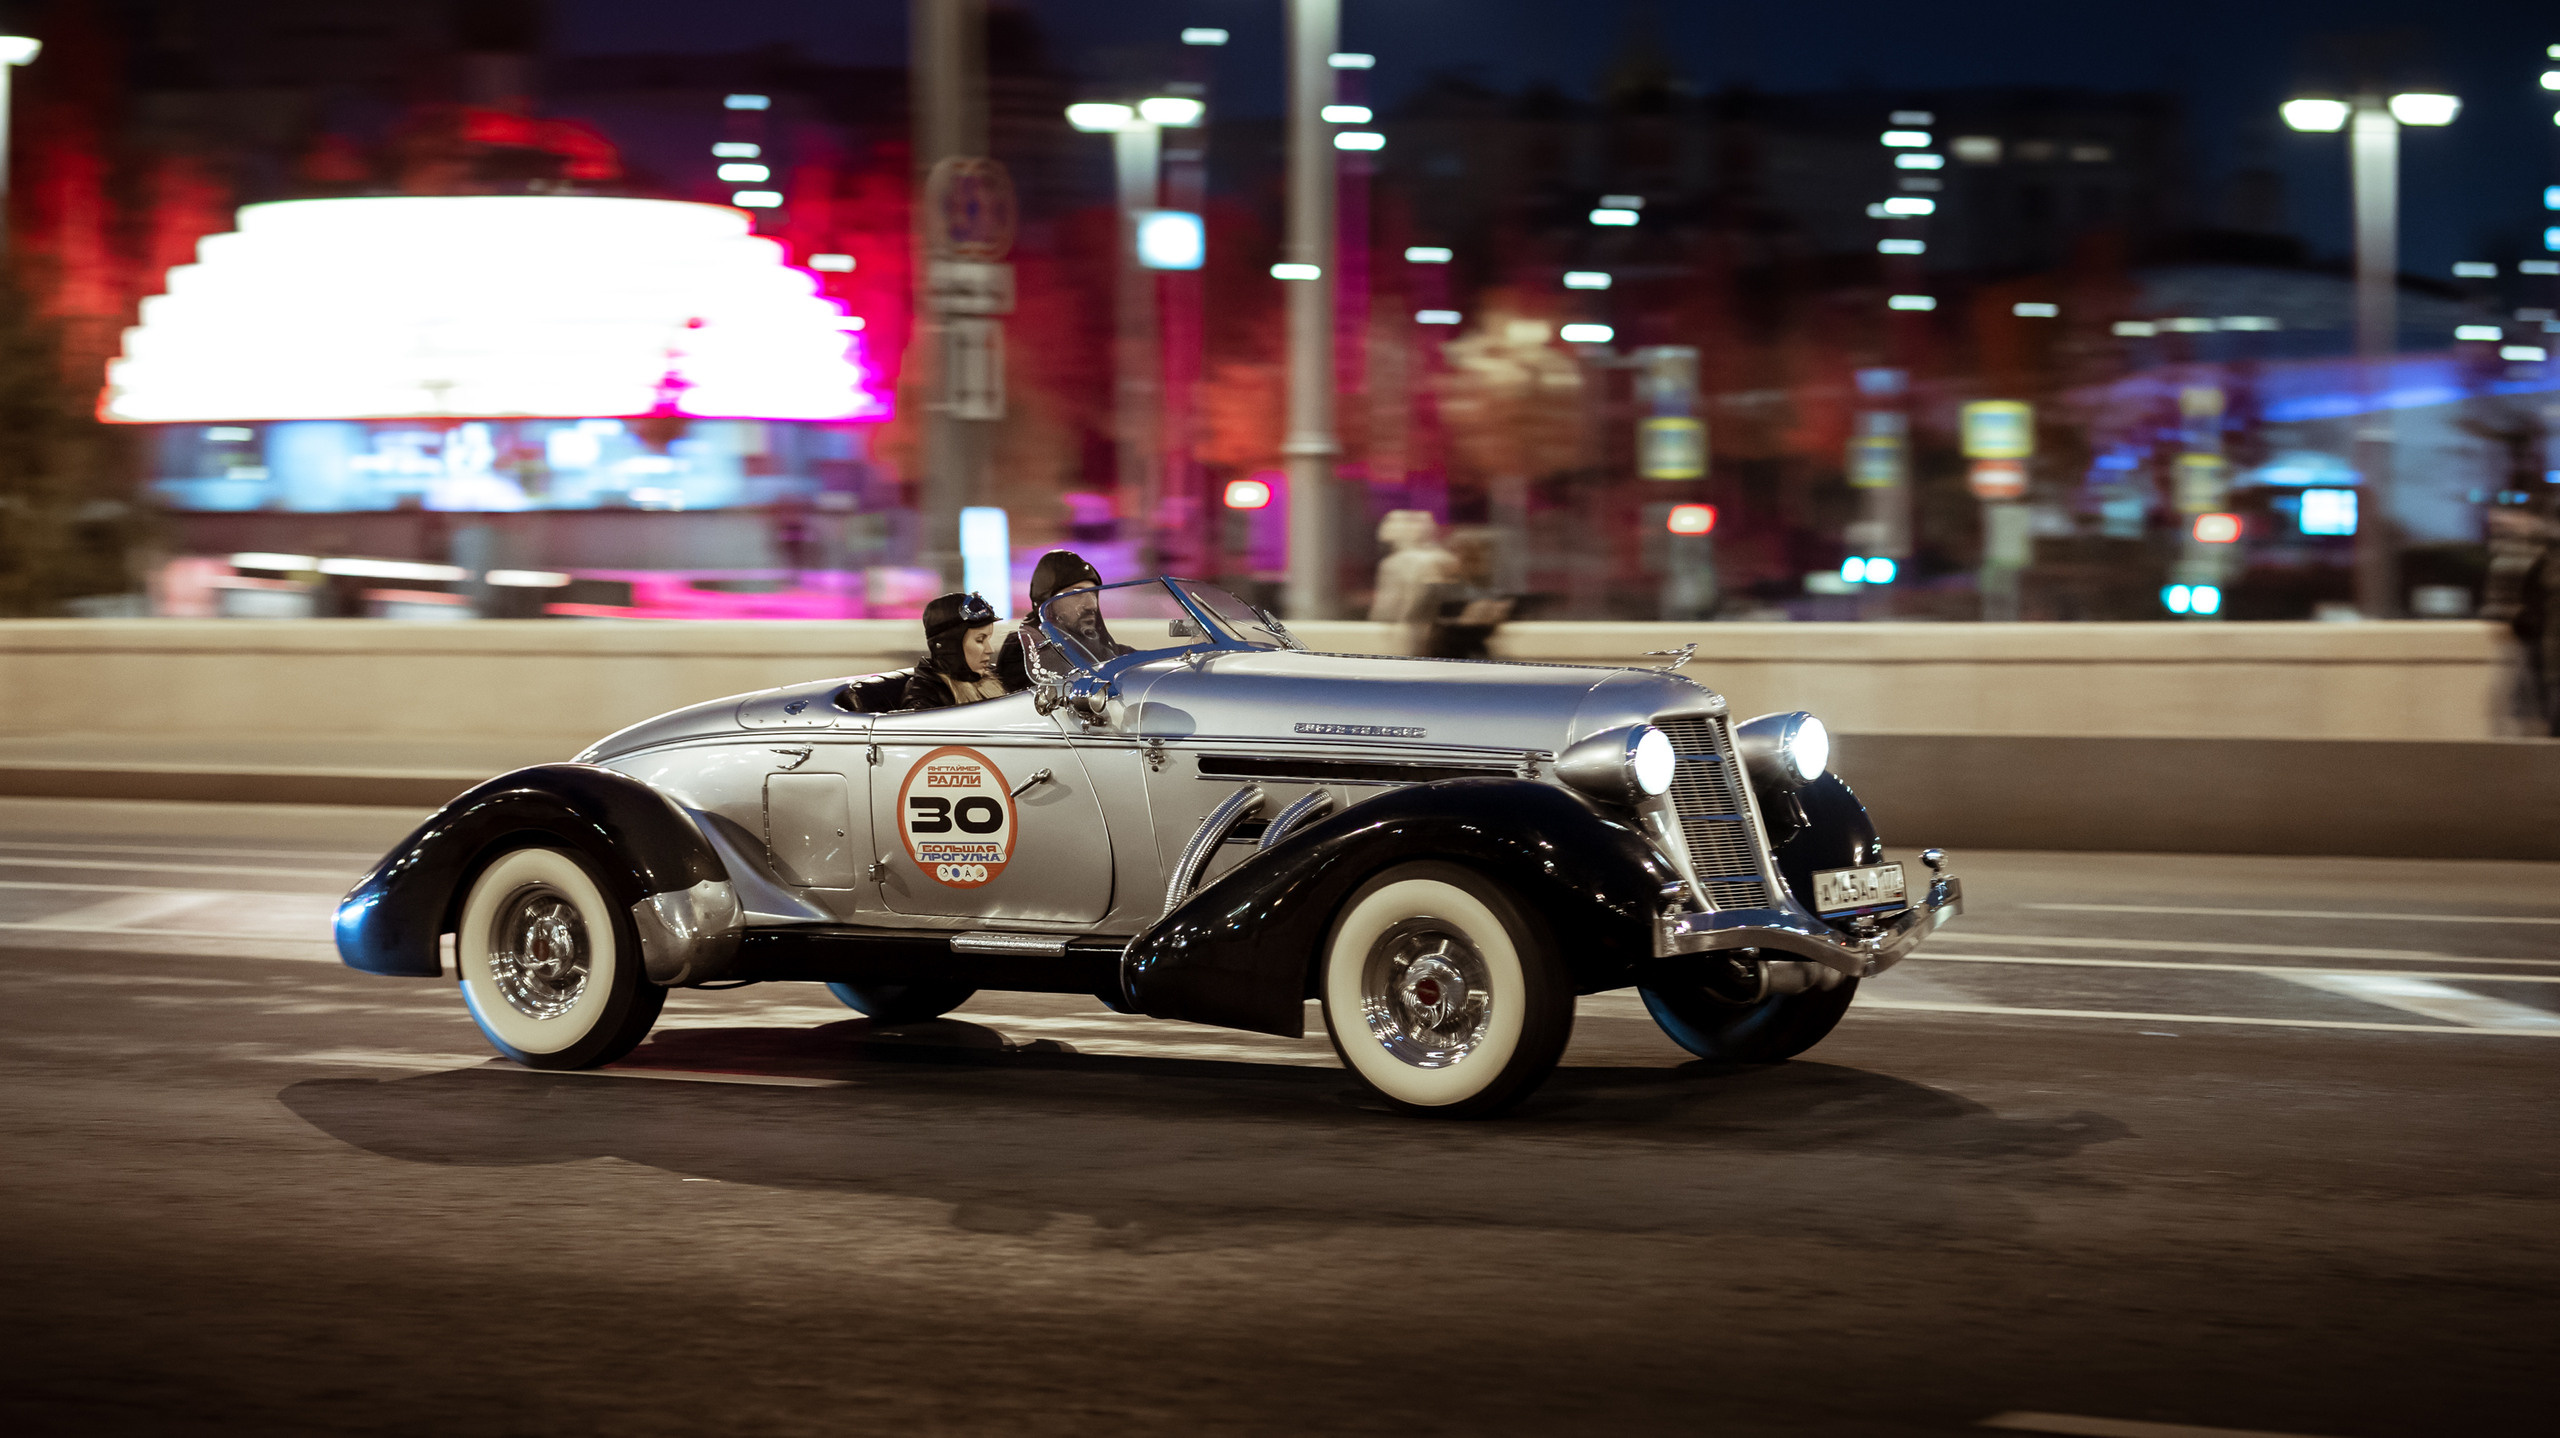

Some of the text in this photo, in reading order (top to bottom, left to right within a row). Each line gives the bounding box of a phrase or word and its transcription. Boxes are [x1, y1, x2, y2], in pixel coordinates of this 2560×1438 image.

[927, 764, 981, 772] ЯНГТАЙМЕР
[927, 775, 981, 787] РАЛЛИ
[909, 796, 1004, 834] 30
[922, 844, 997, 853] БОЛЬШАЯ
